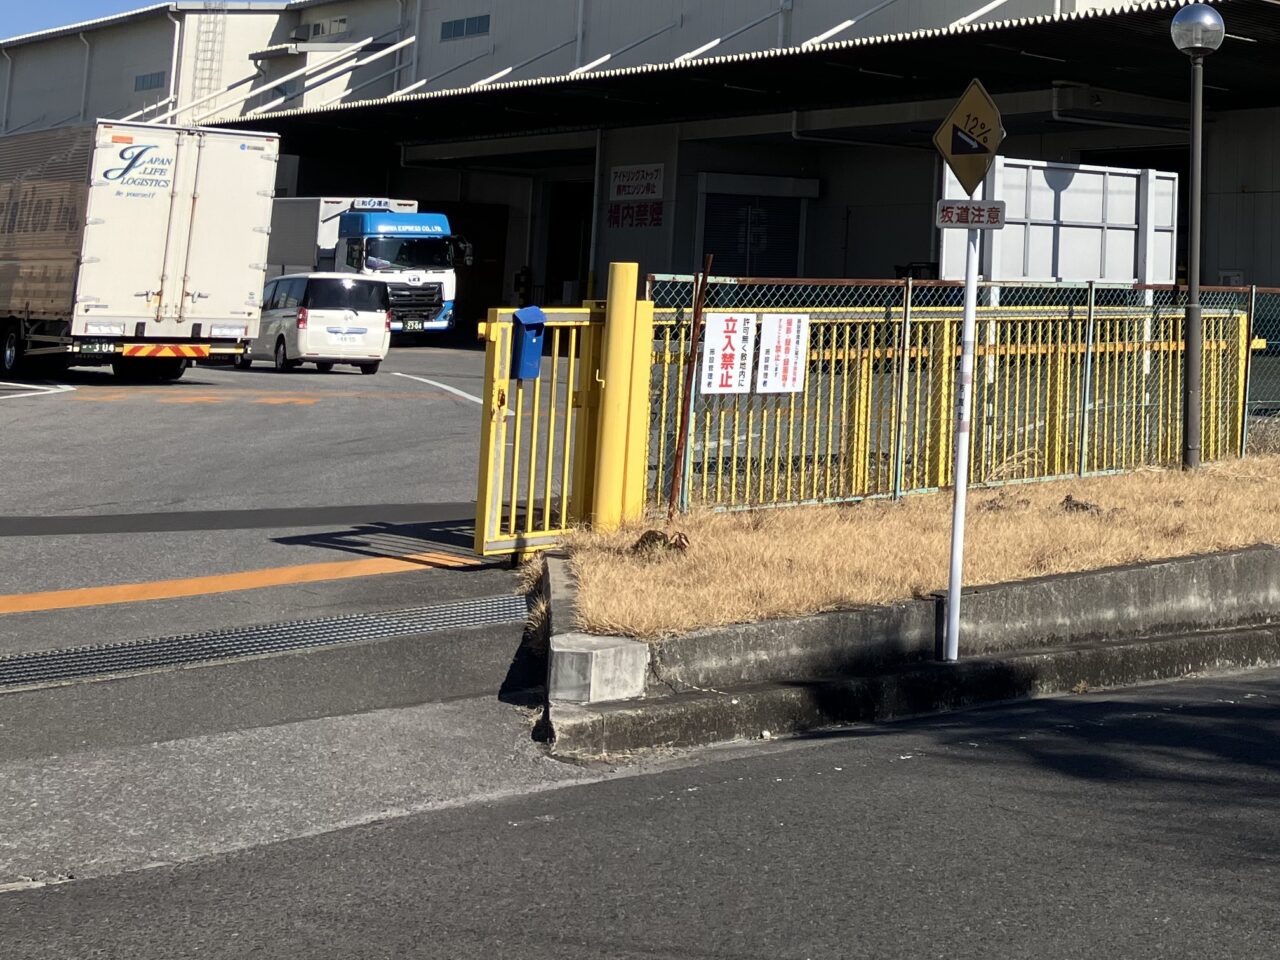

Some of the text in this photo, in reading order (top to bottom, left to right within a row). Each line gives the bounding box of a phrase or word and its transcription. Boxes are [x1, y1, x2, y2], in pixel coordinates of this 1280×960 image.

[963, 112, 992, 144] 12%
[103, 145, 173, 180] JAPAN
[142, 168, 168, 176] LIFE
[120, 177, 171, 187] LOGISTICS
[940, 206, 1001, 224] 坂道注意
[719, 317, 738, 388] 立入禁止
